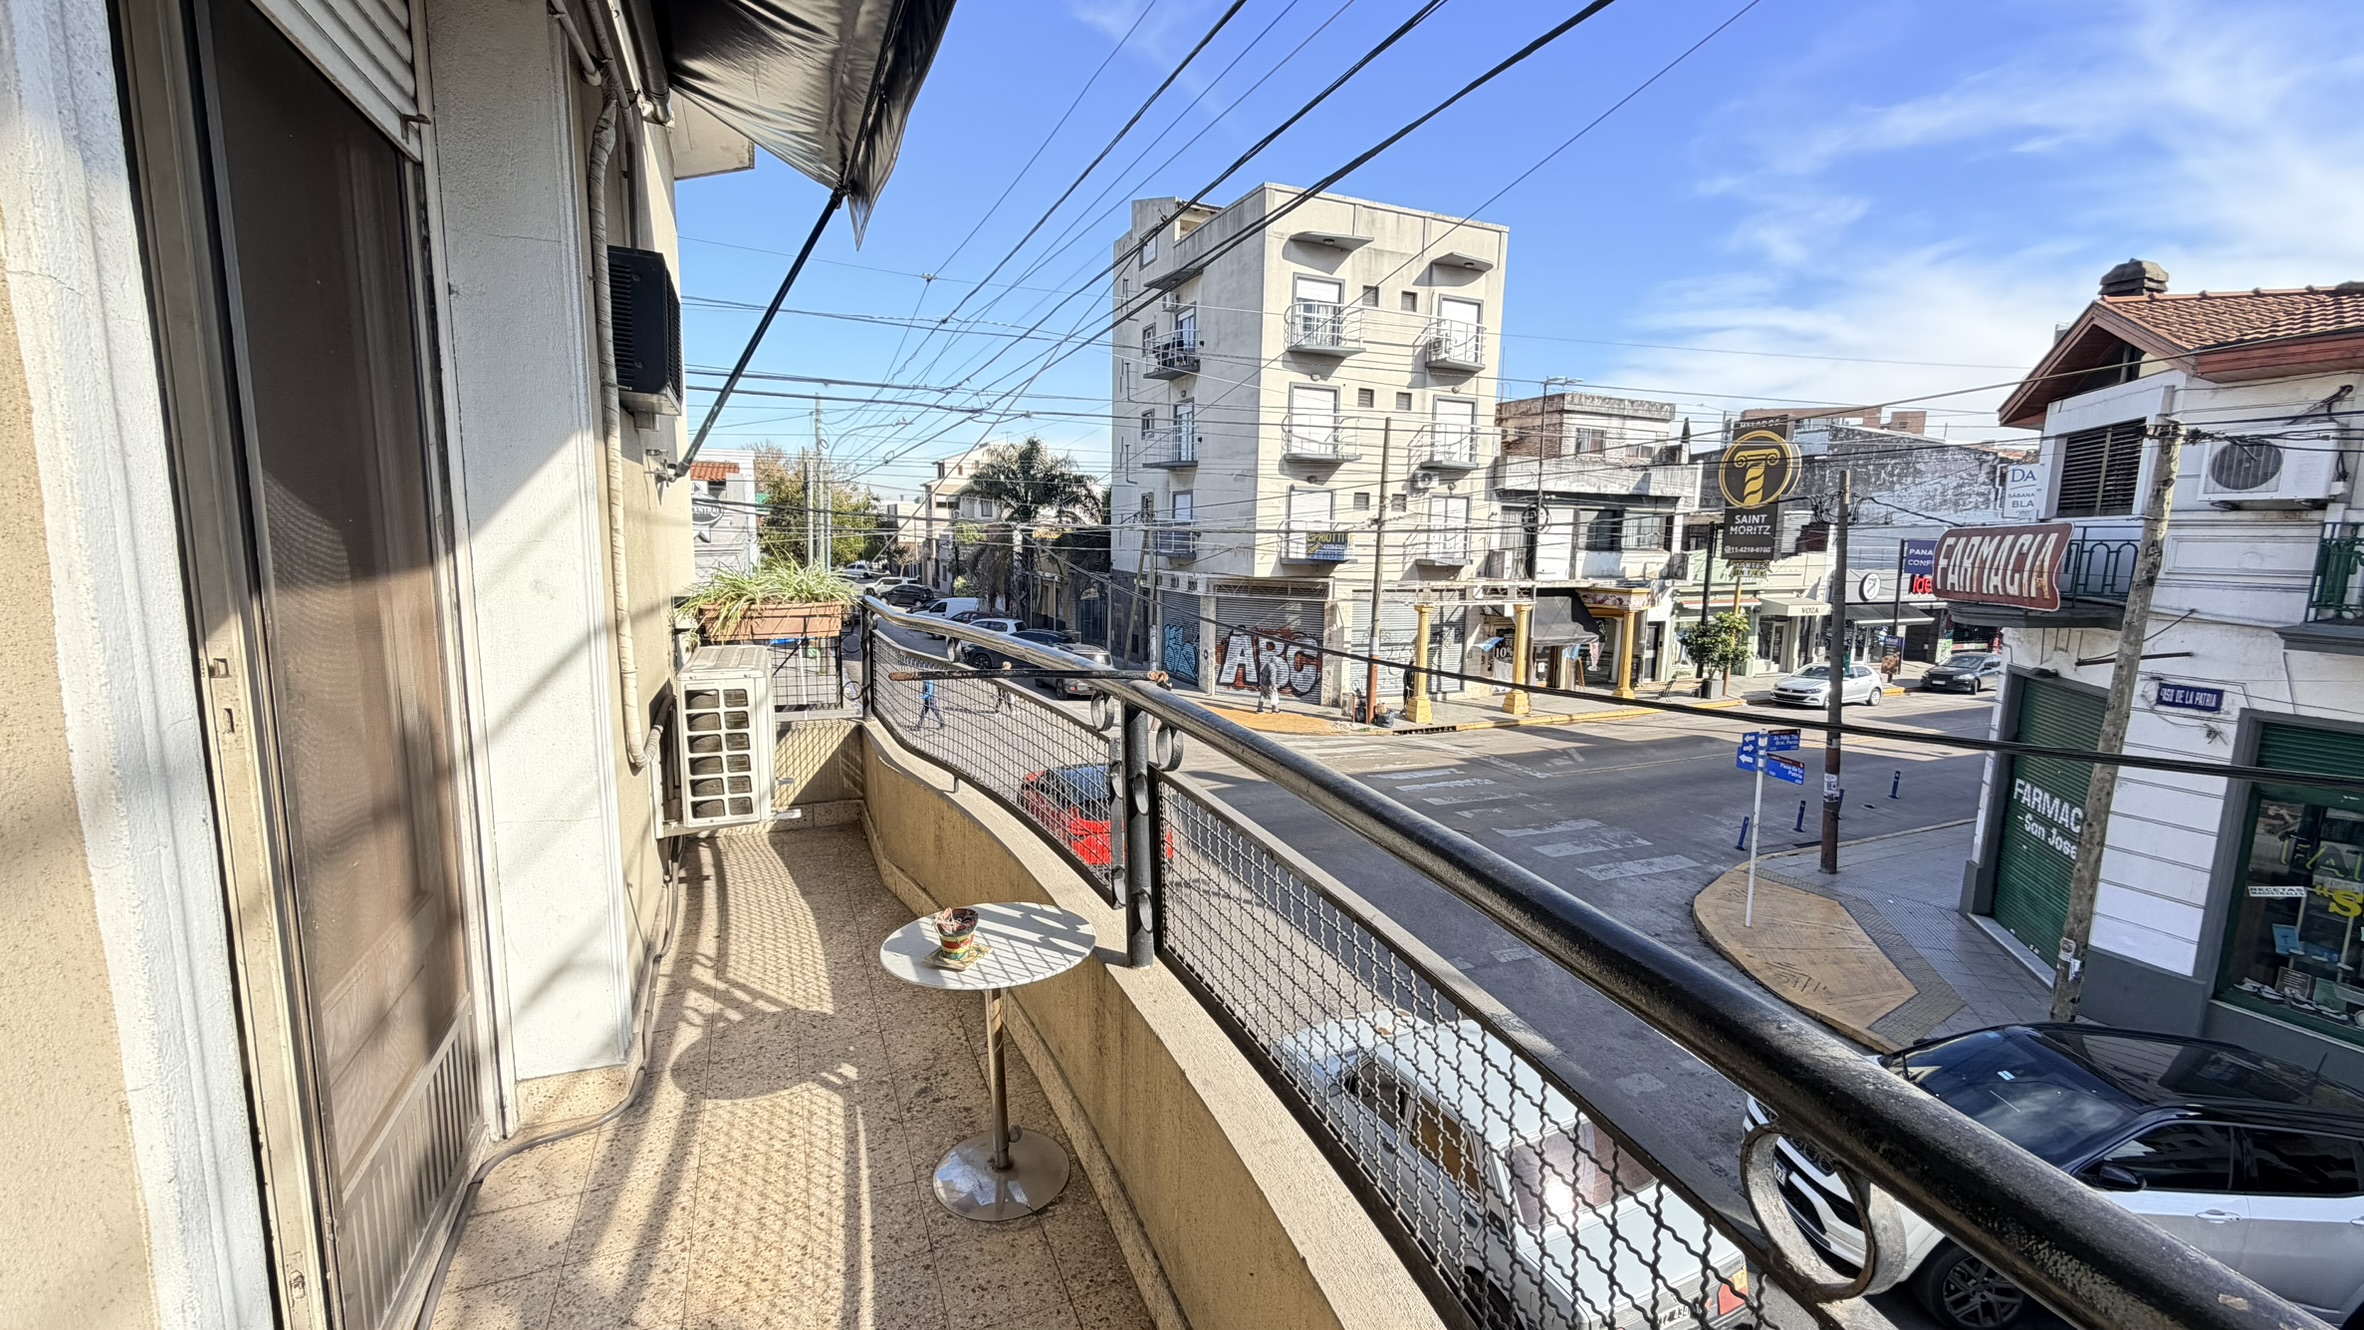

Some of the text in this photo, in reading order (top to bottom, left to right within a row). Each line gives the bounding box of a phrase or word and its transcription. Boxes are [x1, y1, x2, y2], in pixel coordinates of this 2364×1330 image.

[1729, 525, 1771, 535] MORITZ
[1734, 514, 1768, 524] SAINT
[1936, 532, 2059, 599] FARMACIA
[1217, 632, 1321, 695] ABC
[2175, 689, 2185, 703] DE
[2185, 690, 2195, 704] LA
[2194, 692, 2217, 707] PATRIA
[2013, 778, 2084, 833] FARMAC
[2024, 813, 2046, 840] San
